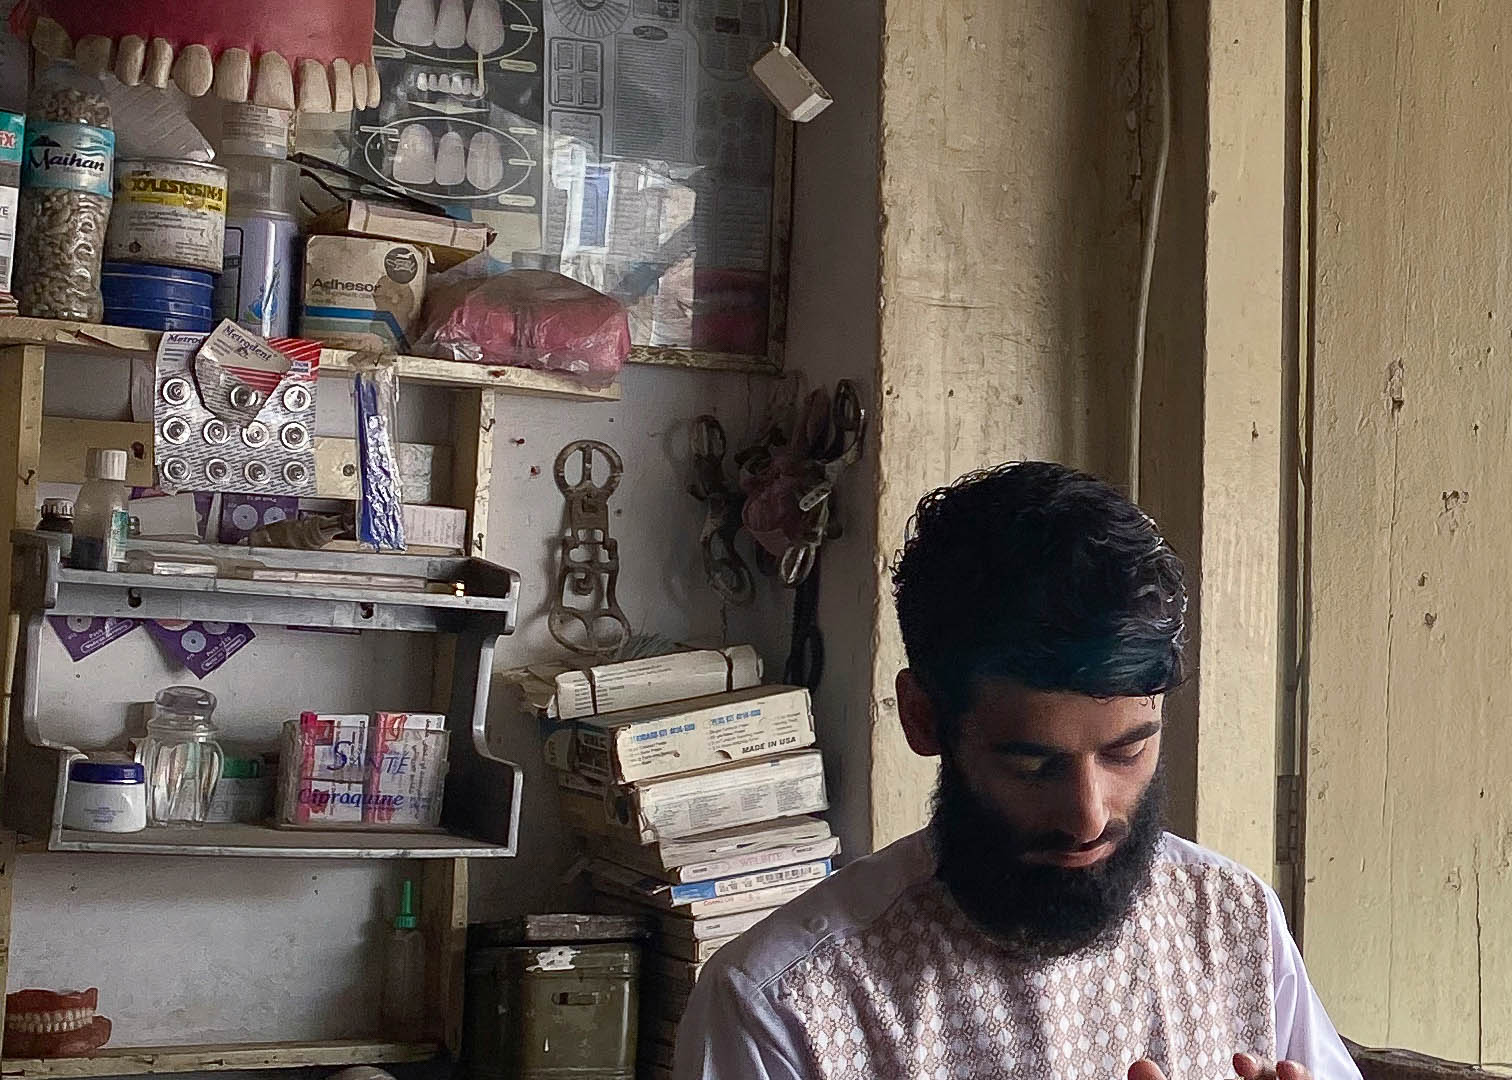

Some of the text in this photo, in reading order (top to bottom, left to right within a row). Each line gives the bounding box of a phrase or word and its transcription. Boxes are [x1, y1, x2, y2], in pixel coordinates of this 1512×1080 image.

[312, 277, 382, 293] Adhesor
[223, 325, 274, 361] Metrodent
[741, 736, 797, 754] MADE IN USA
